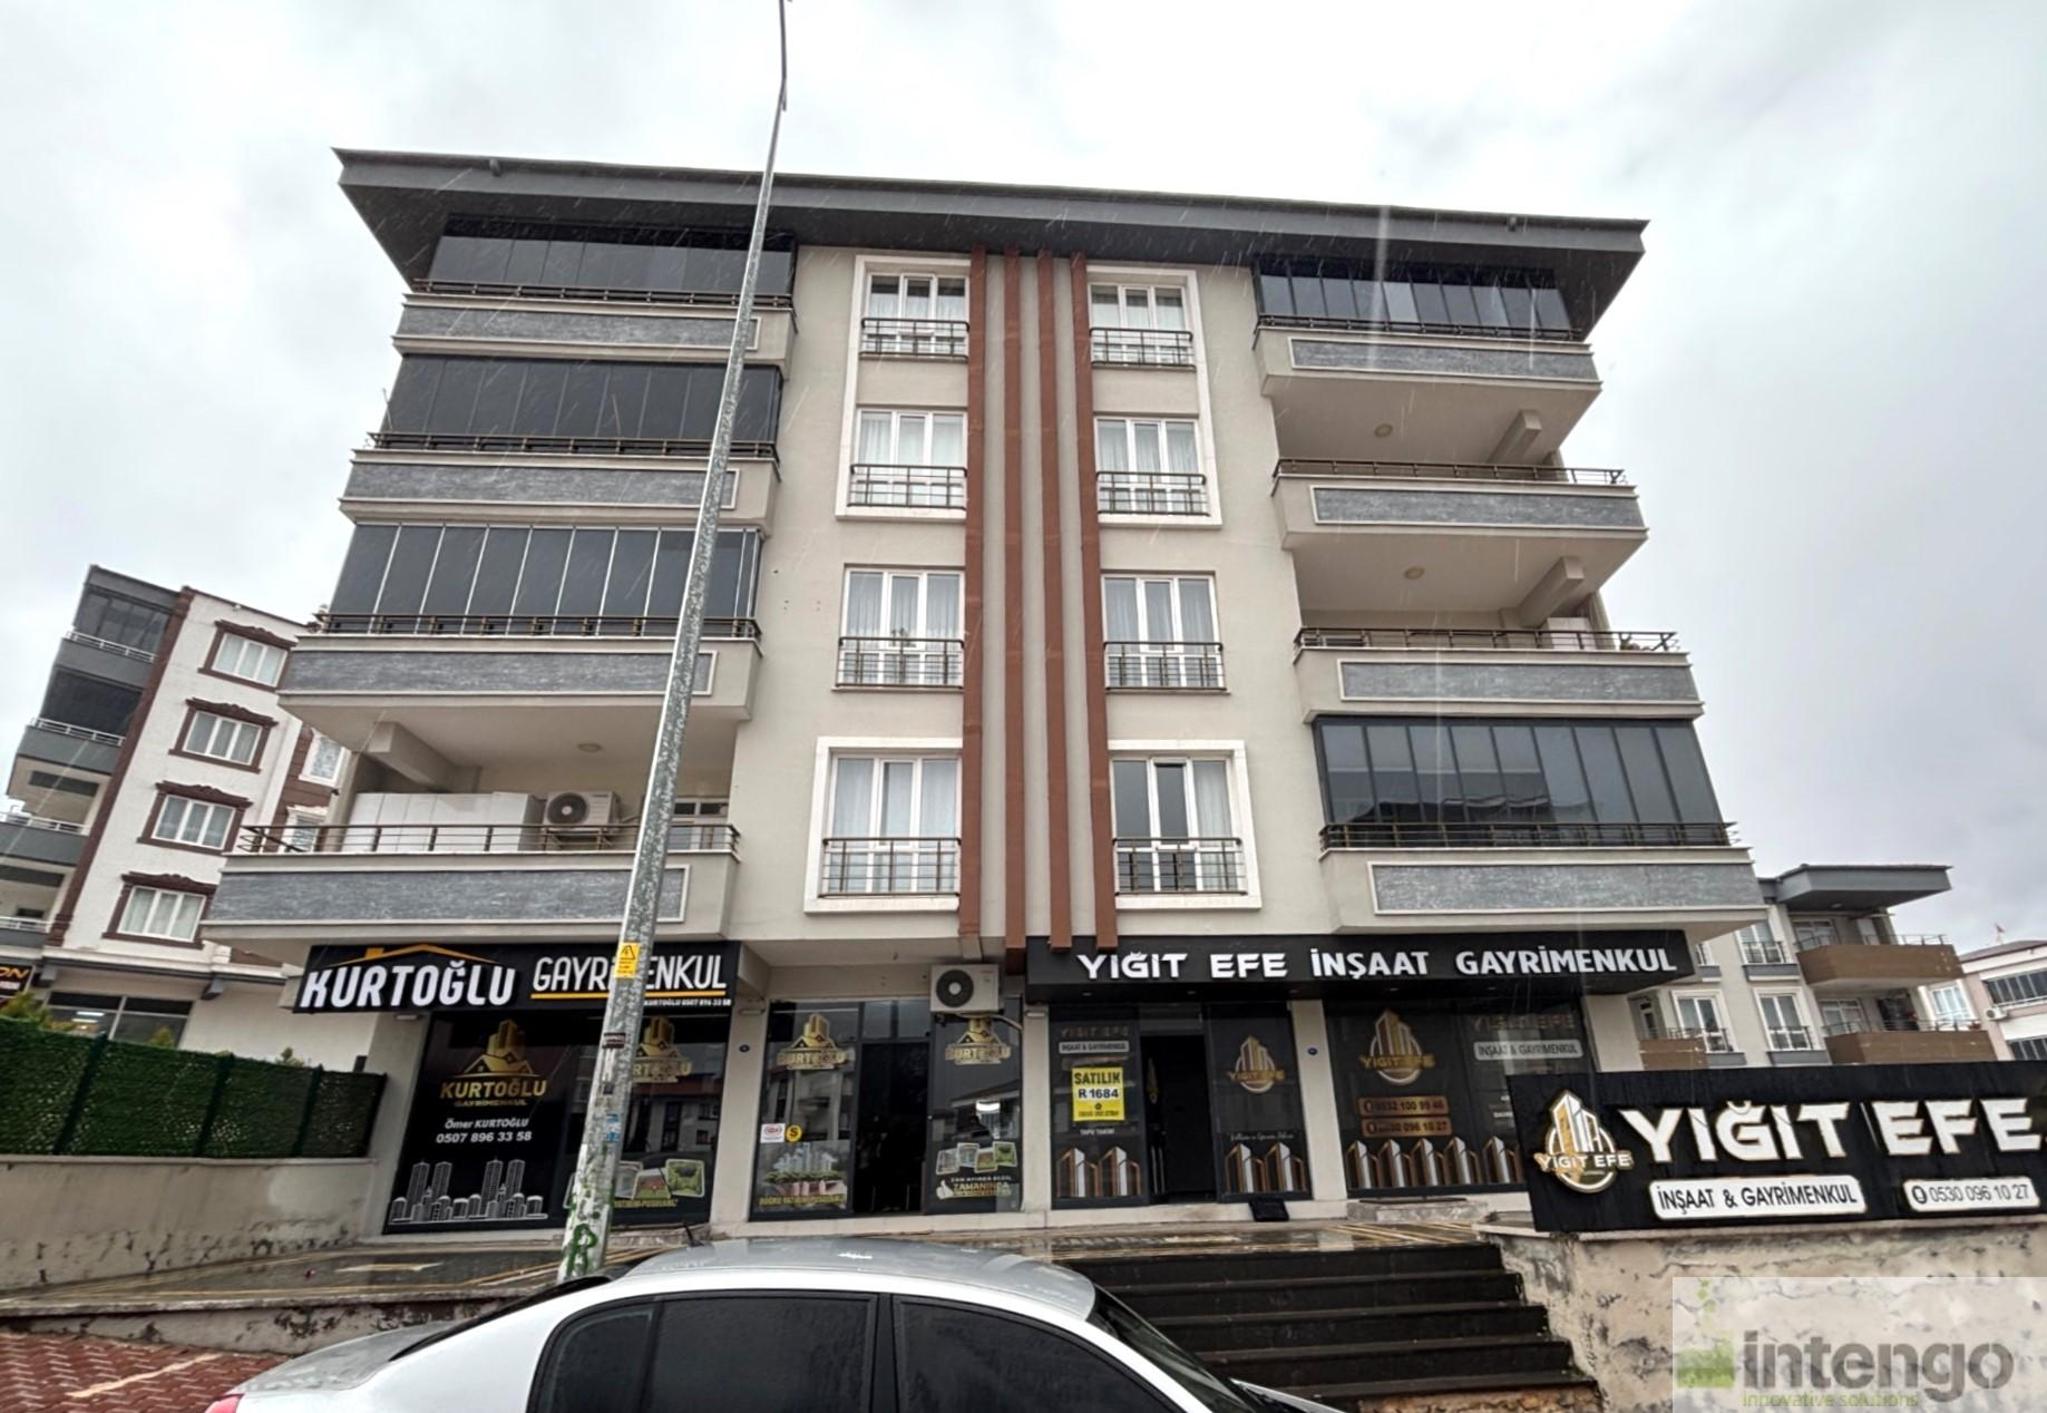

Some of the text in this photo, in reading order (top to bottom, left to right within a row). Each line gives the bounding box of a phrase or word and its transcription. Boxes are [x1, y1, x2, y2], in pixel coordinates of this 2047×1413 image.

[1210, 953, 1288, 979] EFE
[1310, 948, 1429, 979] İNŞAAT
[1456, 946, 1677, 975] GAYRİMENKUL
[300, 960, 515, 1007] KURTOĞLU
[1074, 1072, 1120, 1084] SATILIK
[440, 1079, 547, 1099] KURTOĞLU
[1079, 1089, 1119, 1099] R 1684
[474, 1117, 529, 1128] KURTOĞLU
[1620, 1098, 2041, 1163] YIĞIT EFE
[436, 1131, 532, 1143] 0507 896 33 58
[1657, 1181, 1858, 1214] İNŞAAT & GAYRİMENKUL
[1929, 1184, 2029, 1202] 0530 096 10 27
